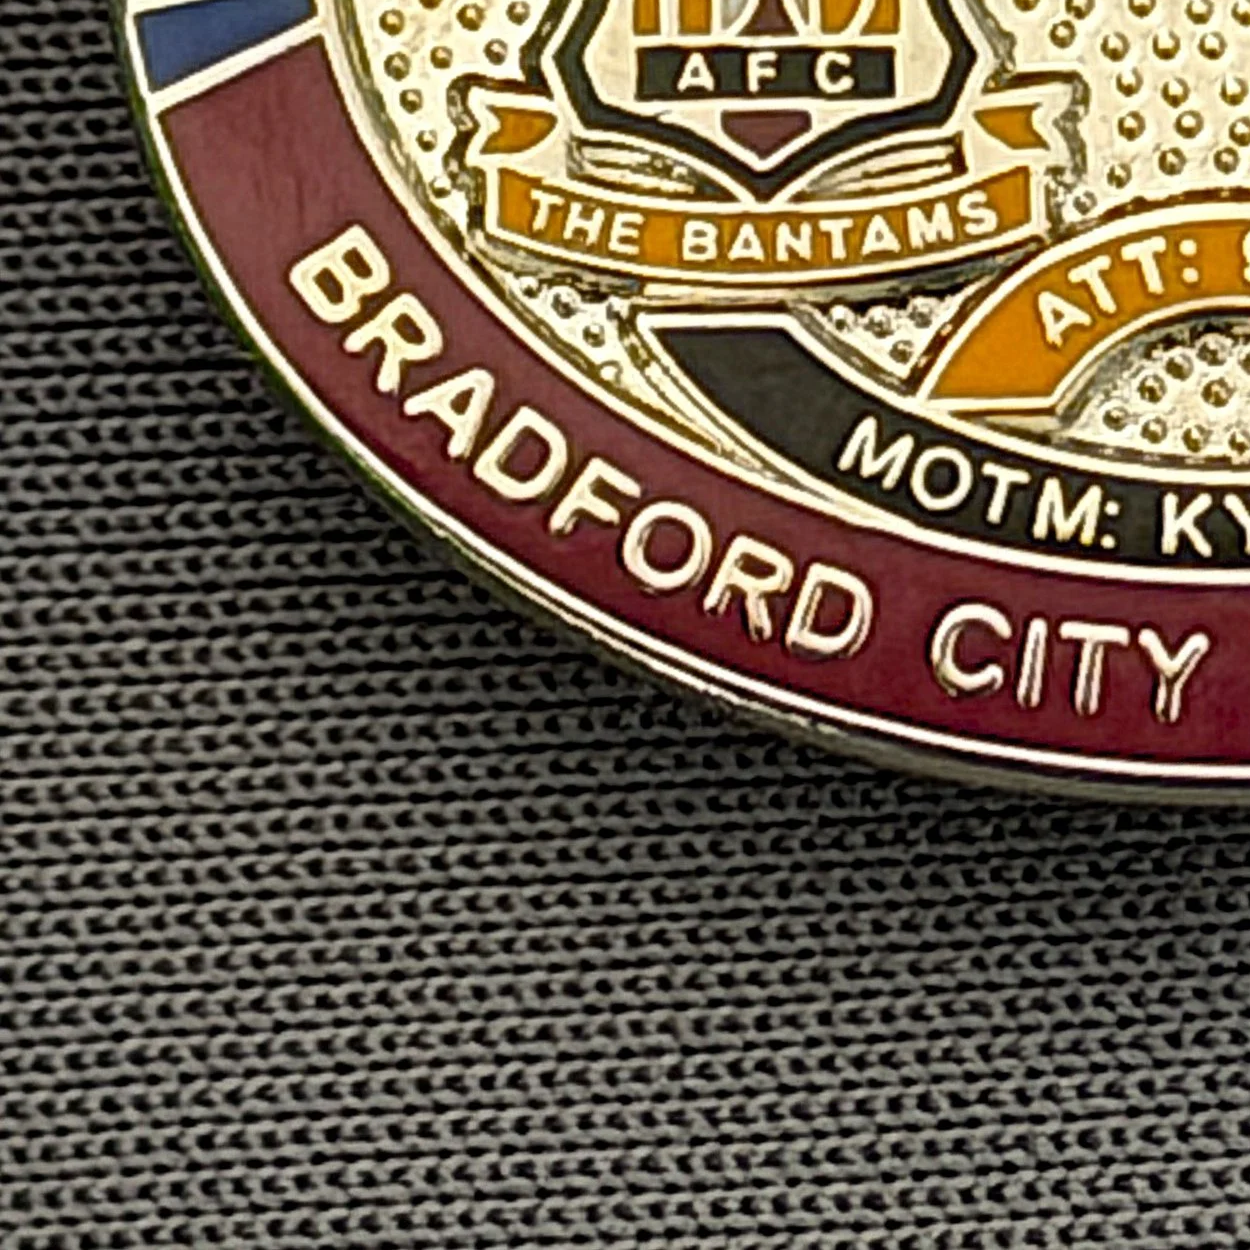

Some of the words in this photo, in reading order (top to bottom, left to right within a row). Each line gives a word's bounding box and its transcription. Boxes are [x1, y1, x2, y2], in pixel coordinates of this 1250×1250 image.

[528, 188, 645, 257] THE
[681, 190, 1000, 263] BANTAMS
[1036, 236, 1200, 347] ATT:
[288, 224, 875, 660] BRADFORD
[930, 602, 1210, 723] CITY
[836, 415, 1120, 550] MOTM:
